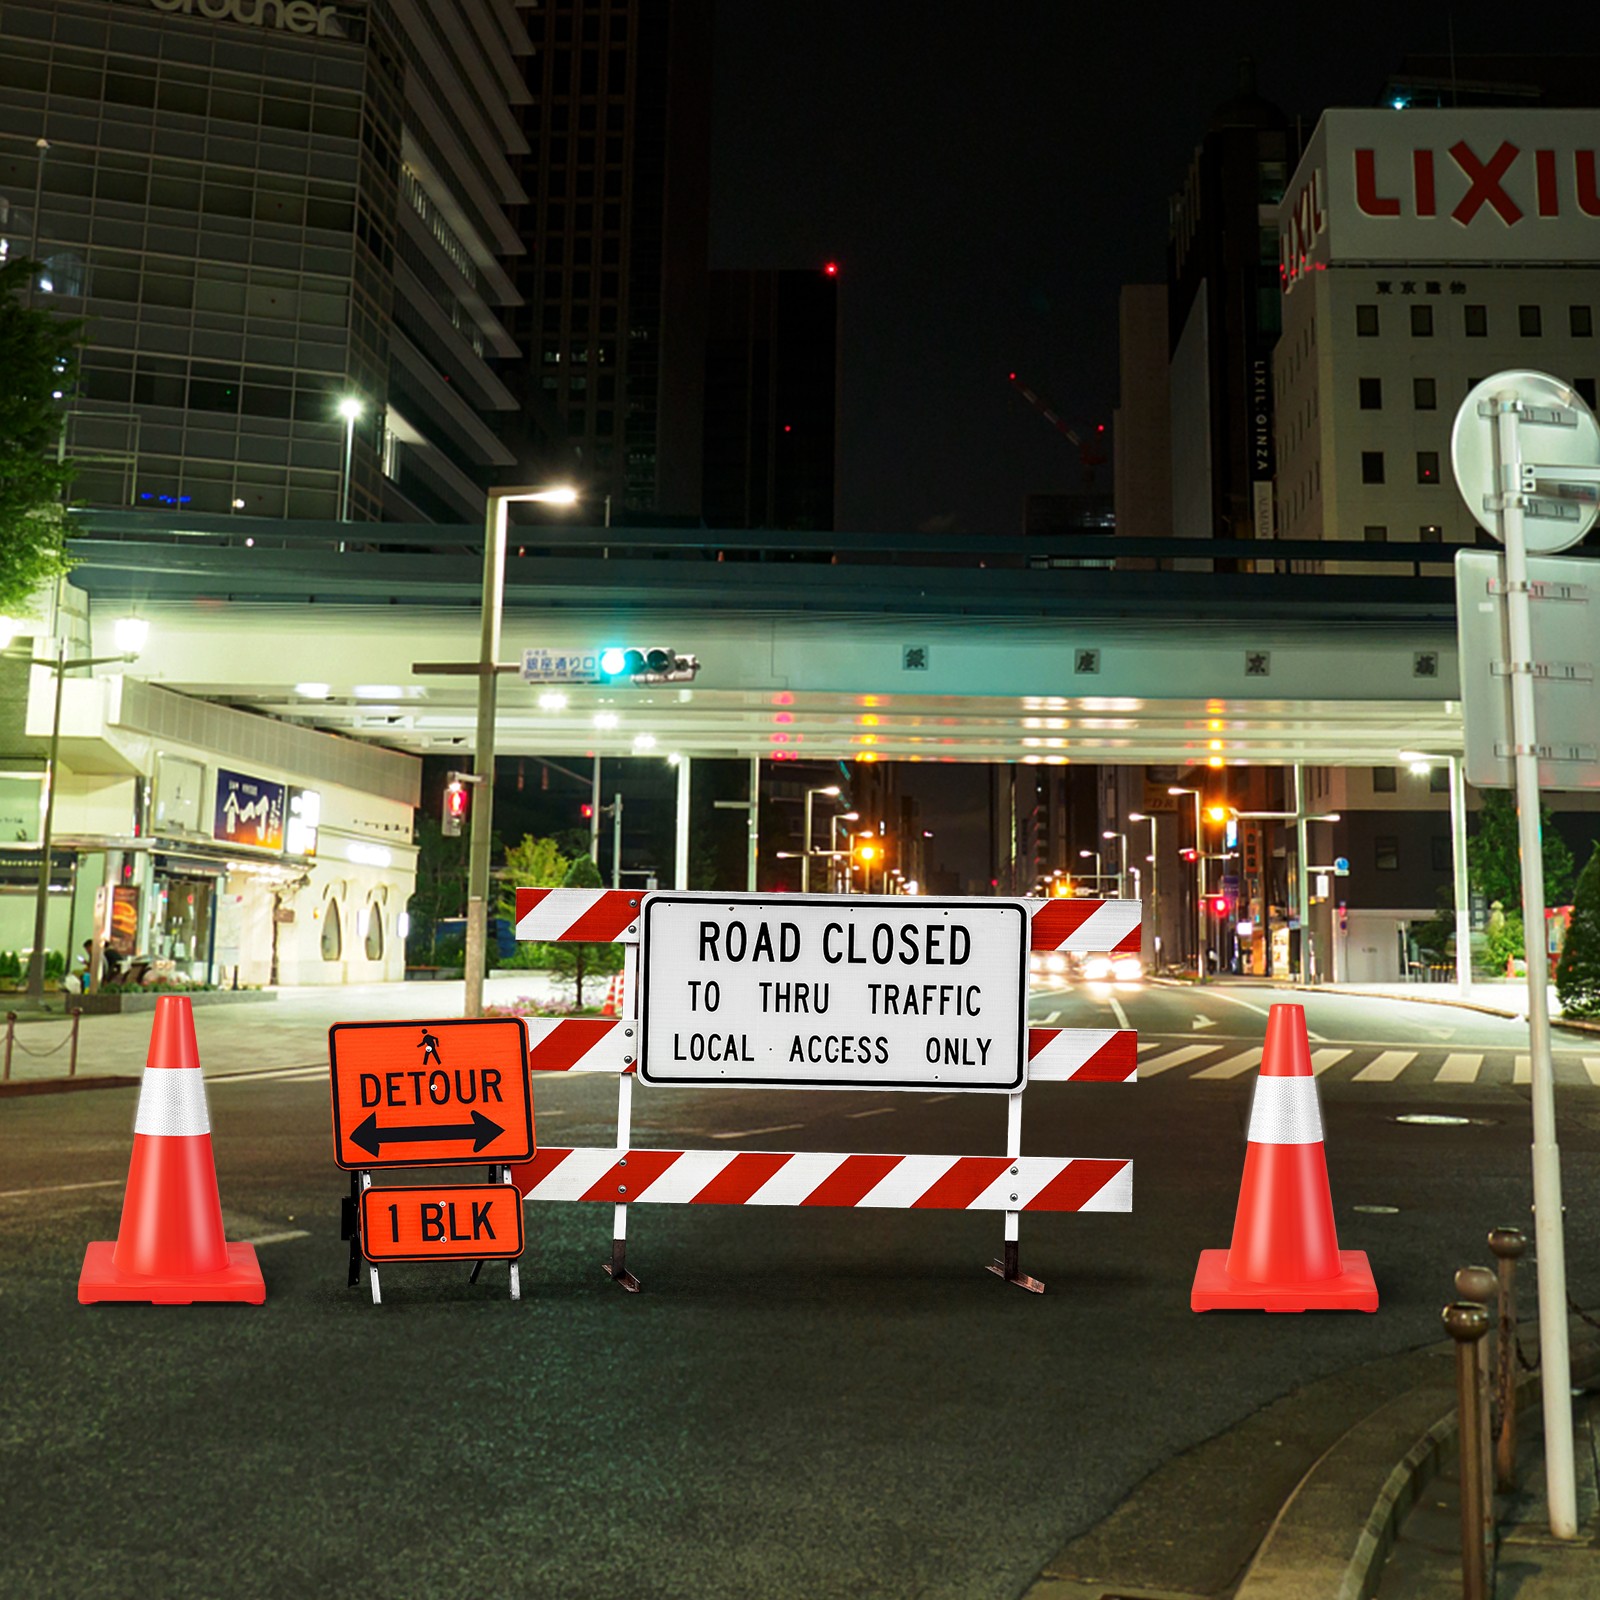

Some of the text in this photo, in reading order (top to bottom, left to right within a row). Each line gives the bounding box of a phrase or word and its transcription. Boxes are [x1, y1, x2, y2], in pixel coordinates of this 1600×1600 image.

[1376, 280, 1467, 295] 東京建物
[699, 920, 971, 966] ROAD CLOSED
[688, 980, 981, 1017] TO THRU TRAFFIC
[674, 1033, 992, 1066] LOCAL ACCESS ONLY
[360, 1068, 504, 1108] DETOUR
[388, 1200, 497, 1243] 1 BLK
